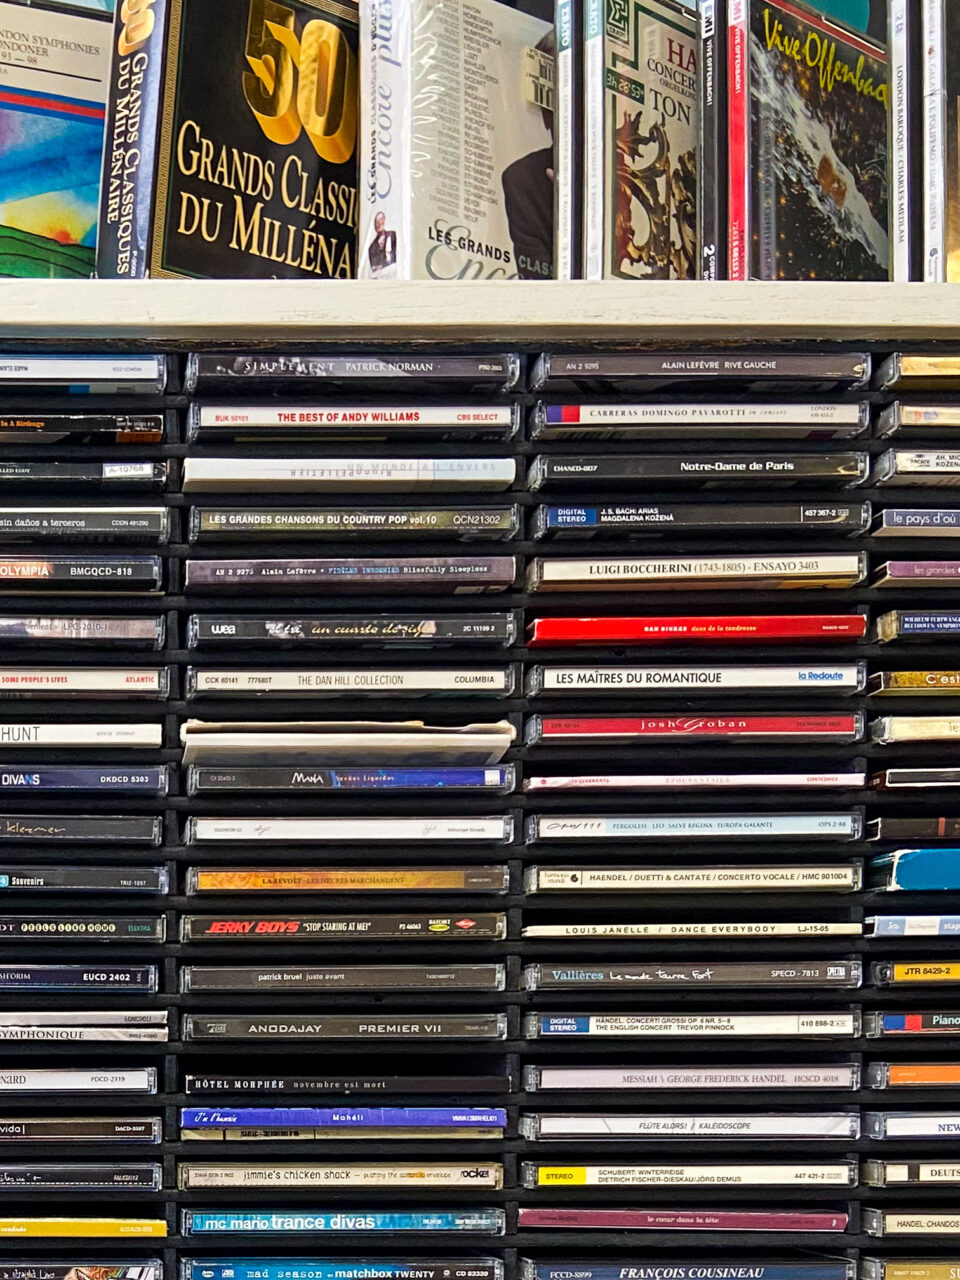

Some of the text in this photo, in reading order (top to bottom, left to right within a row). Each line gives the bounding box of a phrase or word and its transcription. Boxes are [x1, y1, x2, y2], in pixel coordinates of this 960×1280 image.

[764, 8, 801, 60] Vive
[32, 35, 100, 55] SYMPHONIES
[106, 59, 132, 225] DU MILLÉNAIRE
[116, 52, 148, 275] GRANDS CLASSIQUES
[176, 120, 274, 200] GRANDS
[178, 192, 223, 242] DU
[458, 239, 511, 263] GRANDS
[278, 412, 419, 422] THE BEST OF ANDY WILLIAMS
[680, 462, 794, 471] Notre-Dame de Paris
[0, 518, 12, 526] sin
[15, 518, 39, 526] daños
[50, 519, 85, 527] terceros
[209, 516, 499, 524] LES GRANDES CHANSONS DU COUNTRY POP vol.10 QCN21302
[894, 512, 956, 525] le pays d'où
[0, 565, 49, 575] OLYMPIA
[70, 567, 132, 575] BMGQCD-818
[589, 560, 819, 574] LUIGI BOCCHERINI (1743-1805) ENSAYO 3403
[298, 676, 313, 685] THE
[316, 676, 331, 685] DAN
[334, 676, 351, 685] HILL
[354, 676, 403, 685] COLLECTION
[556, 673, 573, 684] LES
[577, 670, 622, 683] MAÎTRES
[627, 673, 642, 683] DU
[646, 672, 721, 684] ROMANTIQUE
[807, 671, 843, 680] Redoute
[1, 726, 40, 742] HUNT
[206, 921, 300, 933] JERKY BOYS
[83, 973, 106, 981] EUCD
[109, 973, 131, 981] 2402
[923, 967, 950, 975] 8429-2
[248, 1025, 322, 1033] ANODAJAY
[359, 1025, 419, 1033] PREMIER
[206, 1216, 375, 1228] mc mario trance divas
[247, 1269, 269, 1278] mad
[335, 1269, 392, 1279] matchbox
[395, 1270, 434, 1278] TWENTY
[619, 1267, 764, 1280] FRANÇOIS COUSINEAU
